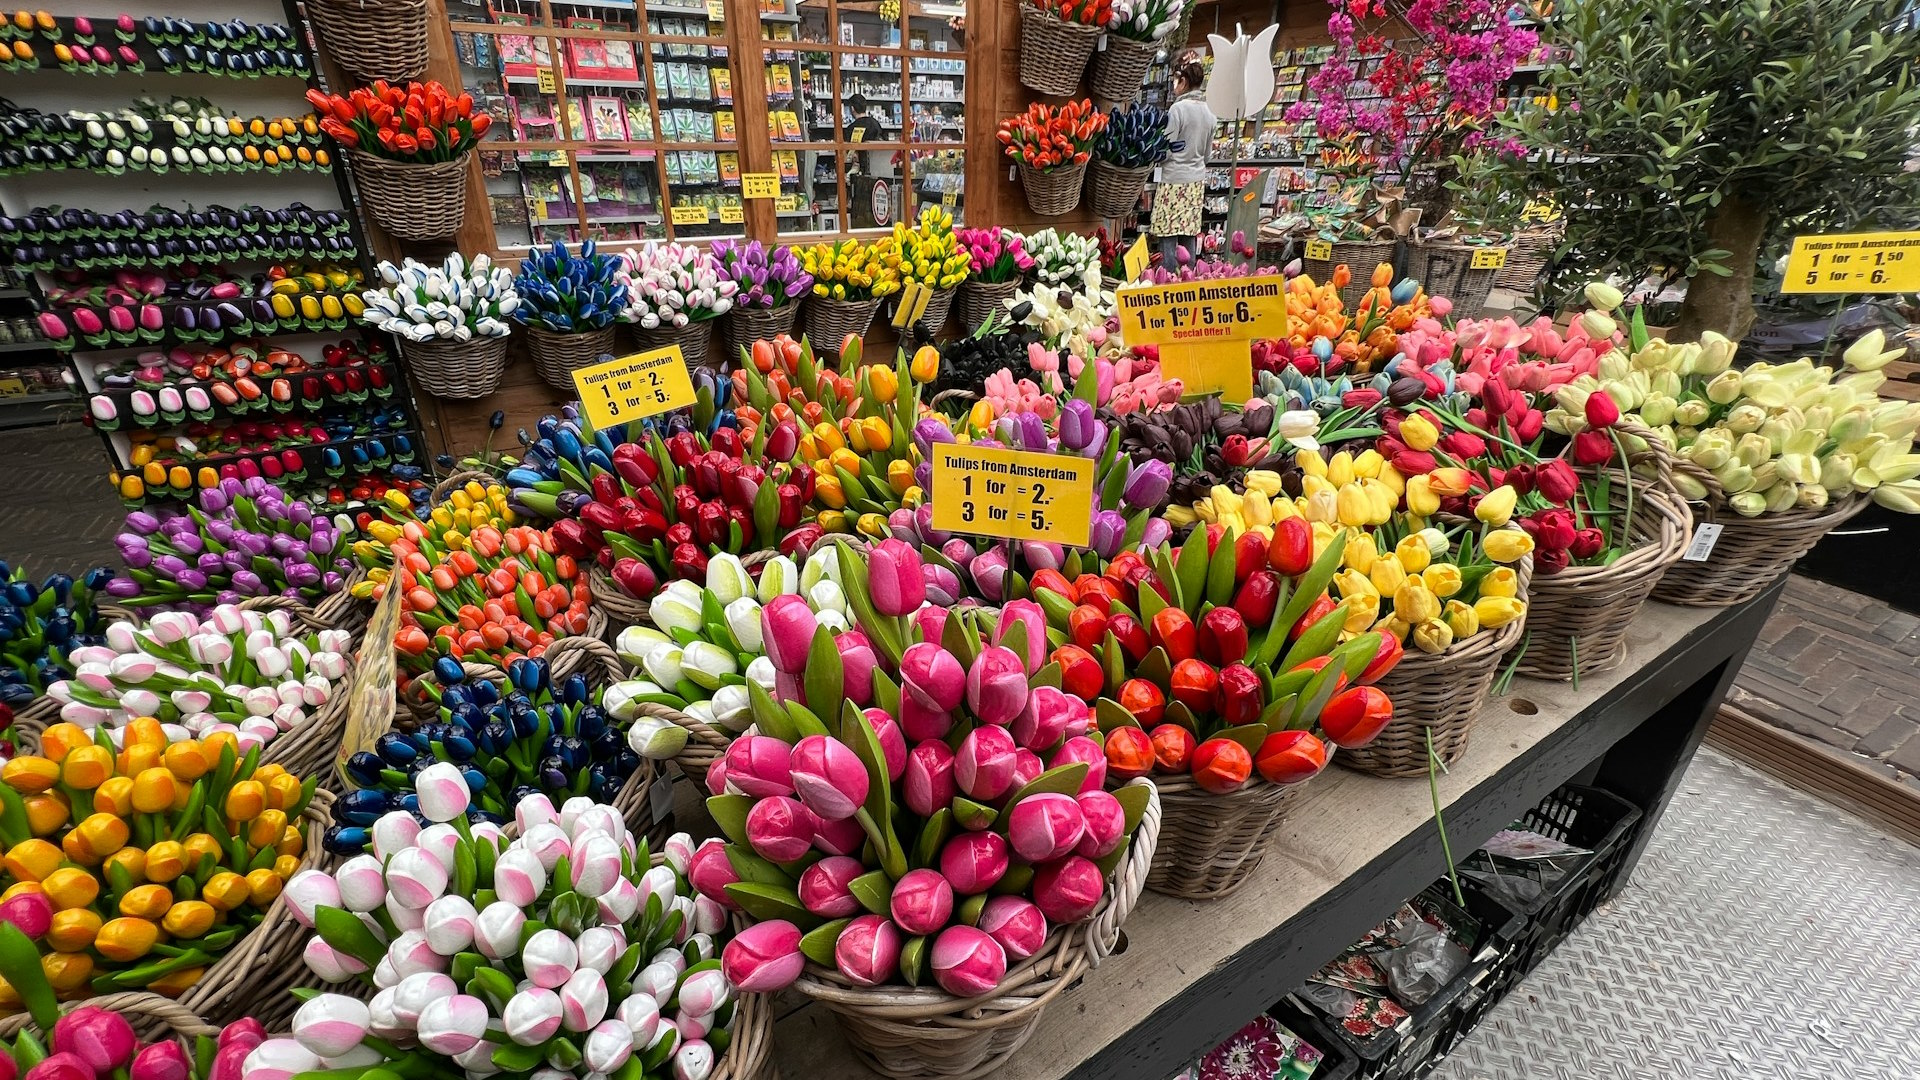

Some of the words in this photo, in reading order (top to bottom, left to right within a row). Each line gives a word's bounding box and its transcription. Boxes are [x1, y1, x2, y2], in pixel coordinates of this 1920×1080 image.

[1861, 239, 1920, 248] Amsterdam
[1812, 254, 1820, 267] 1
[1832, 254, 1850, 264] for
[1806, 271, 1818, 284] 5
[1829, 272, 1848, 281] for
[1122, 295, 1161, 308] Tulips
[1163, 290, 1196, 304] From
[1199, 283, 1278, 301] Amsterdam
[1136, 310, 1146, 330] 1
[1150, 317, 1165, 329] for
[1202, 307, 1214, 324] 5
[1218, 312, 1233, 324] for
[1173, 329, 1202, 339] Special
[1204, 328, 1223, 337] Offer
[584, 372, 608, 385] Tulips
[609, 367, 628, 378] from
[629, 356, 673, 373] Amsterdam
[601, 384, 610, 398] 1
[618, 380, 632, 391] for
[608, 401, 619, 416] 3
[626, 397, 640, 408] for
[945, 456, 978, 470] Tulips
[981, 460, 1008, 474] from
[1010, 463, 1077, 481] Amsterdam
[962, 476, 972, 496] 1
[986, 479, 1006, 494] for
[962, 501, 974, 522] 3
[988, 505, 1008, 520] for
